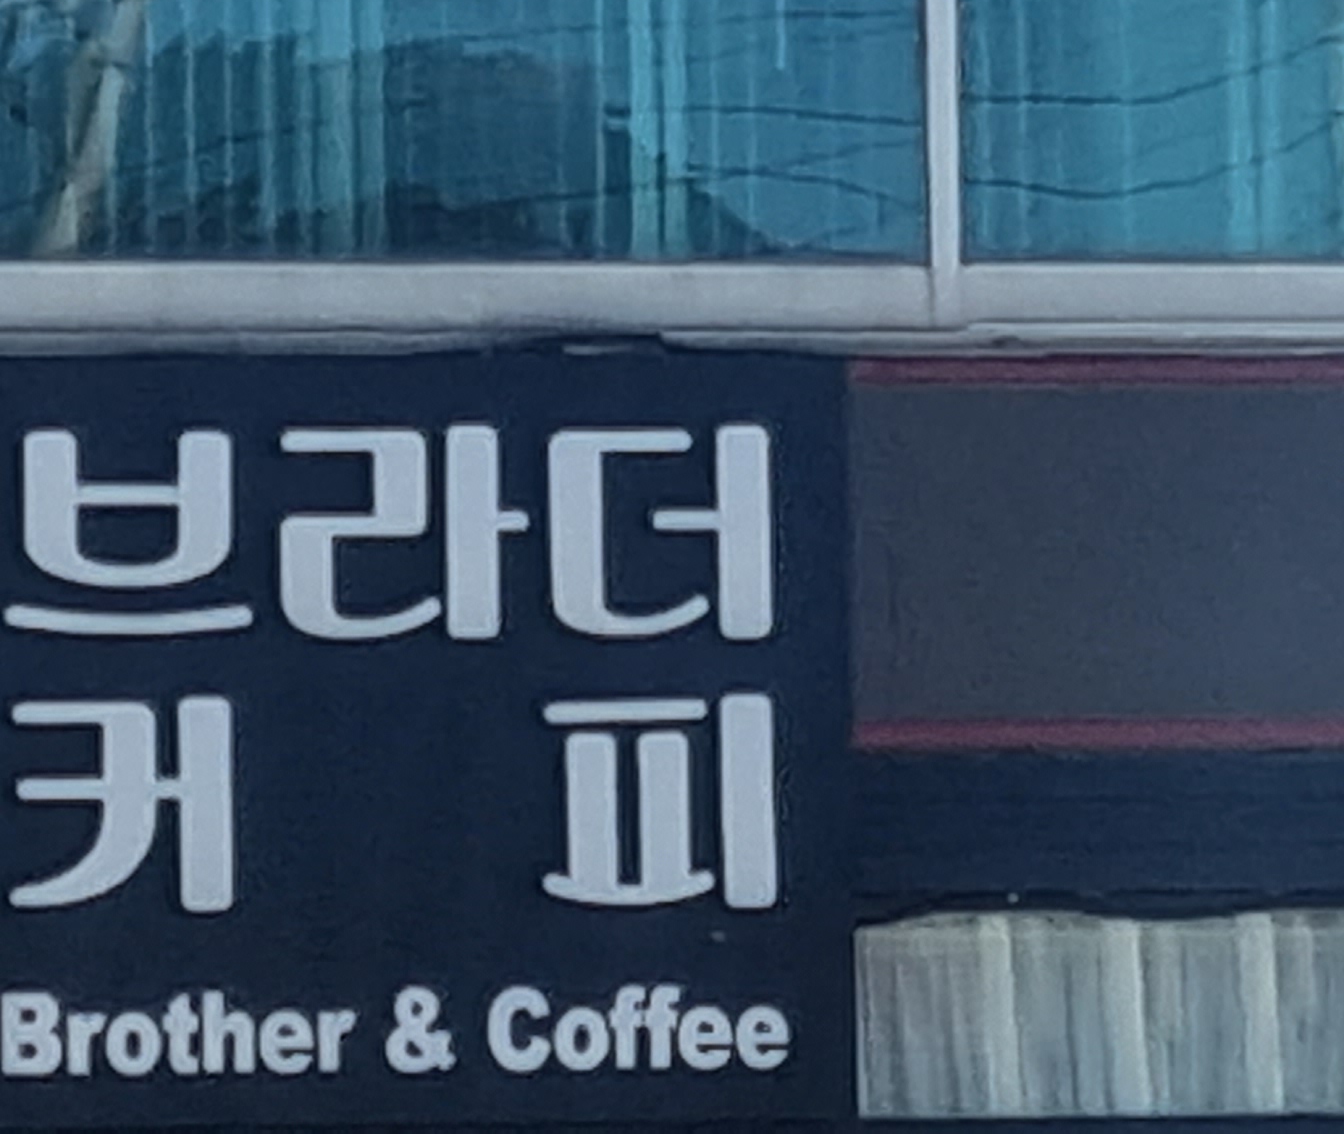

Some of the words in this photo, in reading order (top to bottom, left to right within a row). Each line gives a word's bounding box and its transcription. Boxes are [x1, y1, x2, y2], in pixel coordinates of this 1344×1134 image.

[3, 424, 774, 640] 브라더
[1, 990, 356, 1075] Brother
[386, 986, 456, 1072] &
[487, 985, 791, 1072] Coffee
